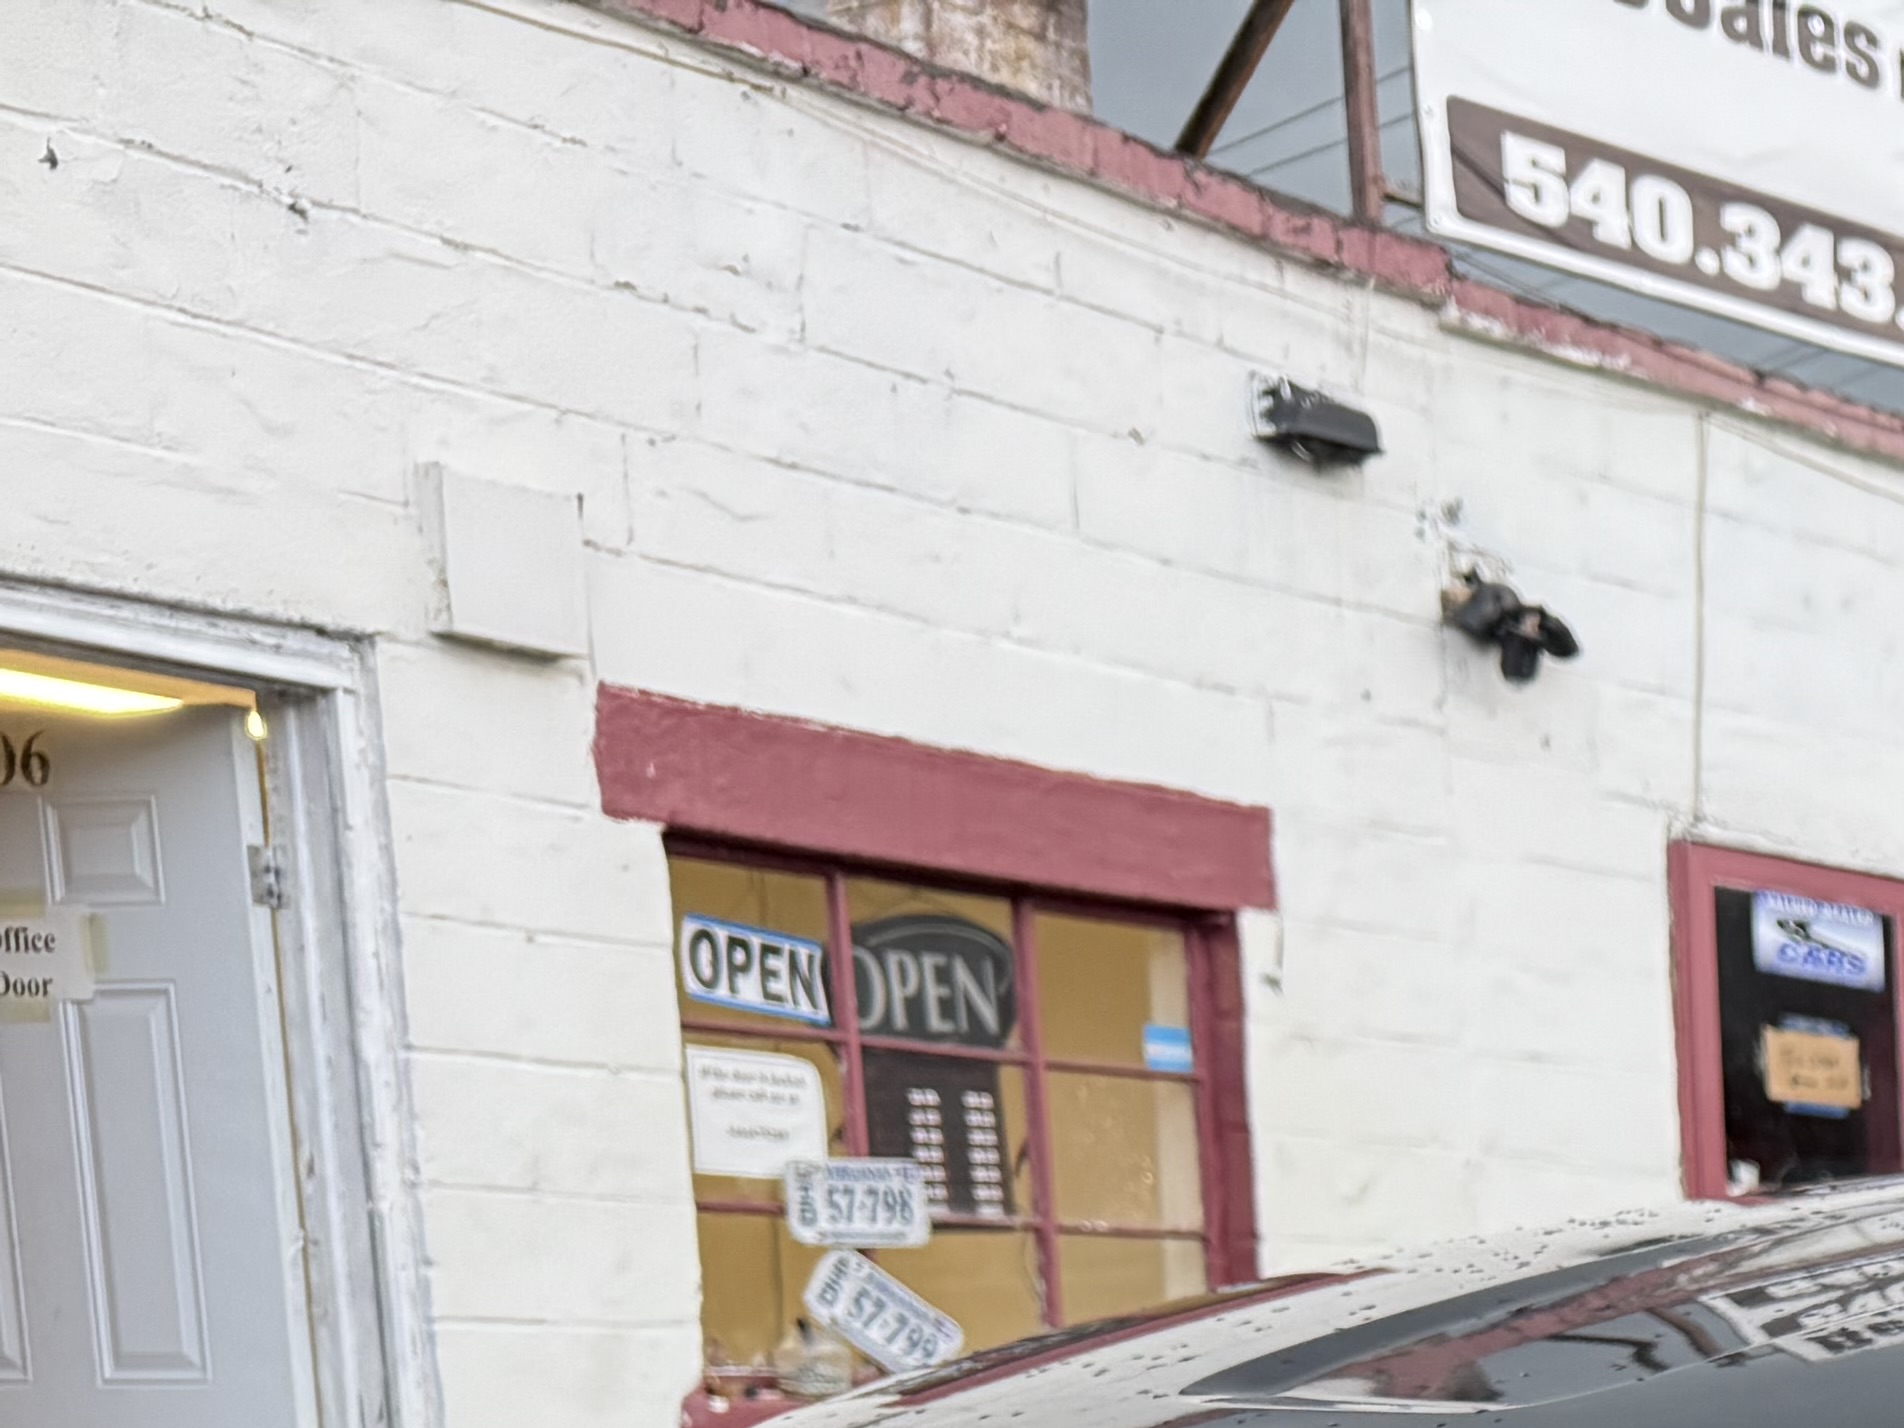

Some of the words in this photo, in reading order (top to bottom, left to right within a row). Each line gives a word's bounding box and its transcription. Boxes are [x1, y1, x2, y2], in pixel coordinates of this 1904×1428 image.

[0, 926, 56, 954] ffice
[689, 927, 823, 1010] OPEN
[1777, 942, 1867, 977] CARS
[853, 942, 1000, 1037] OPEN
